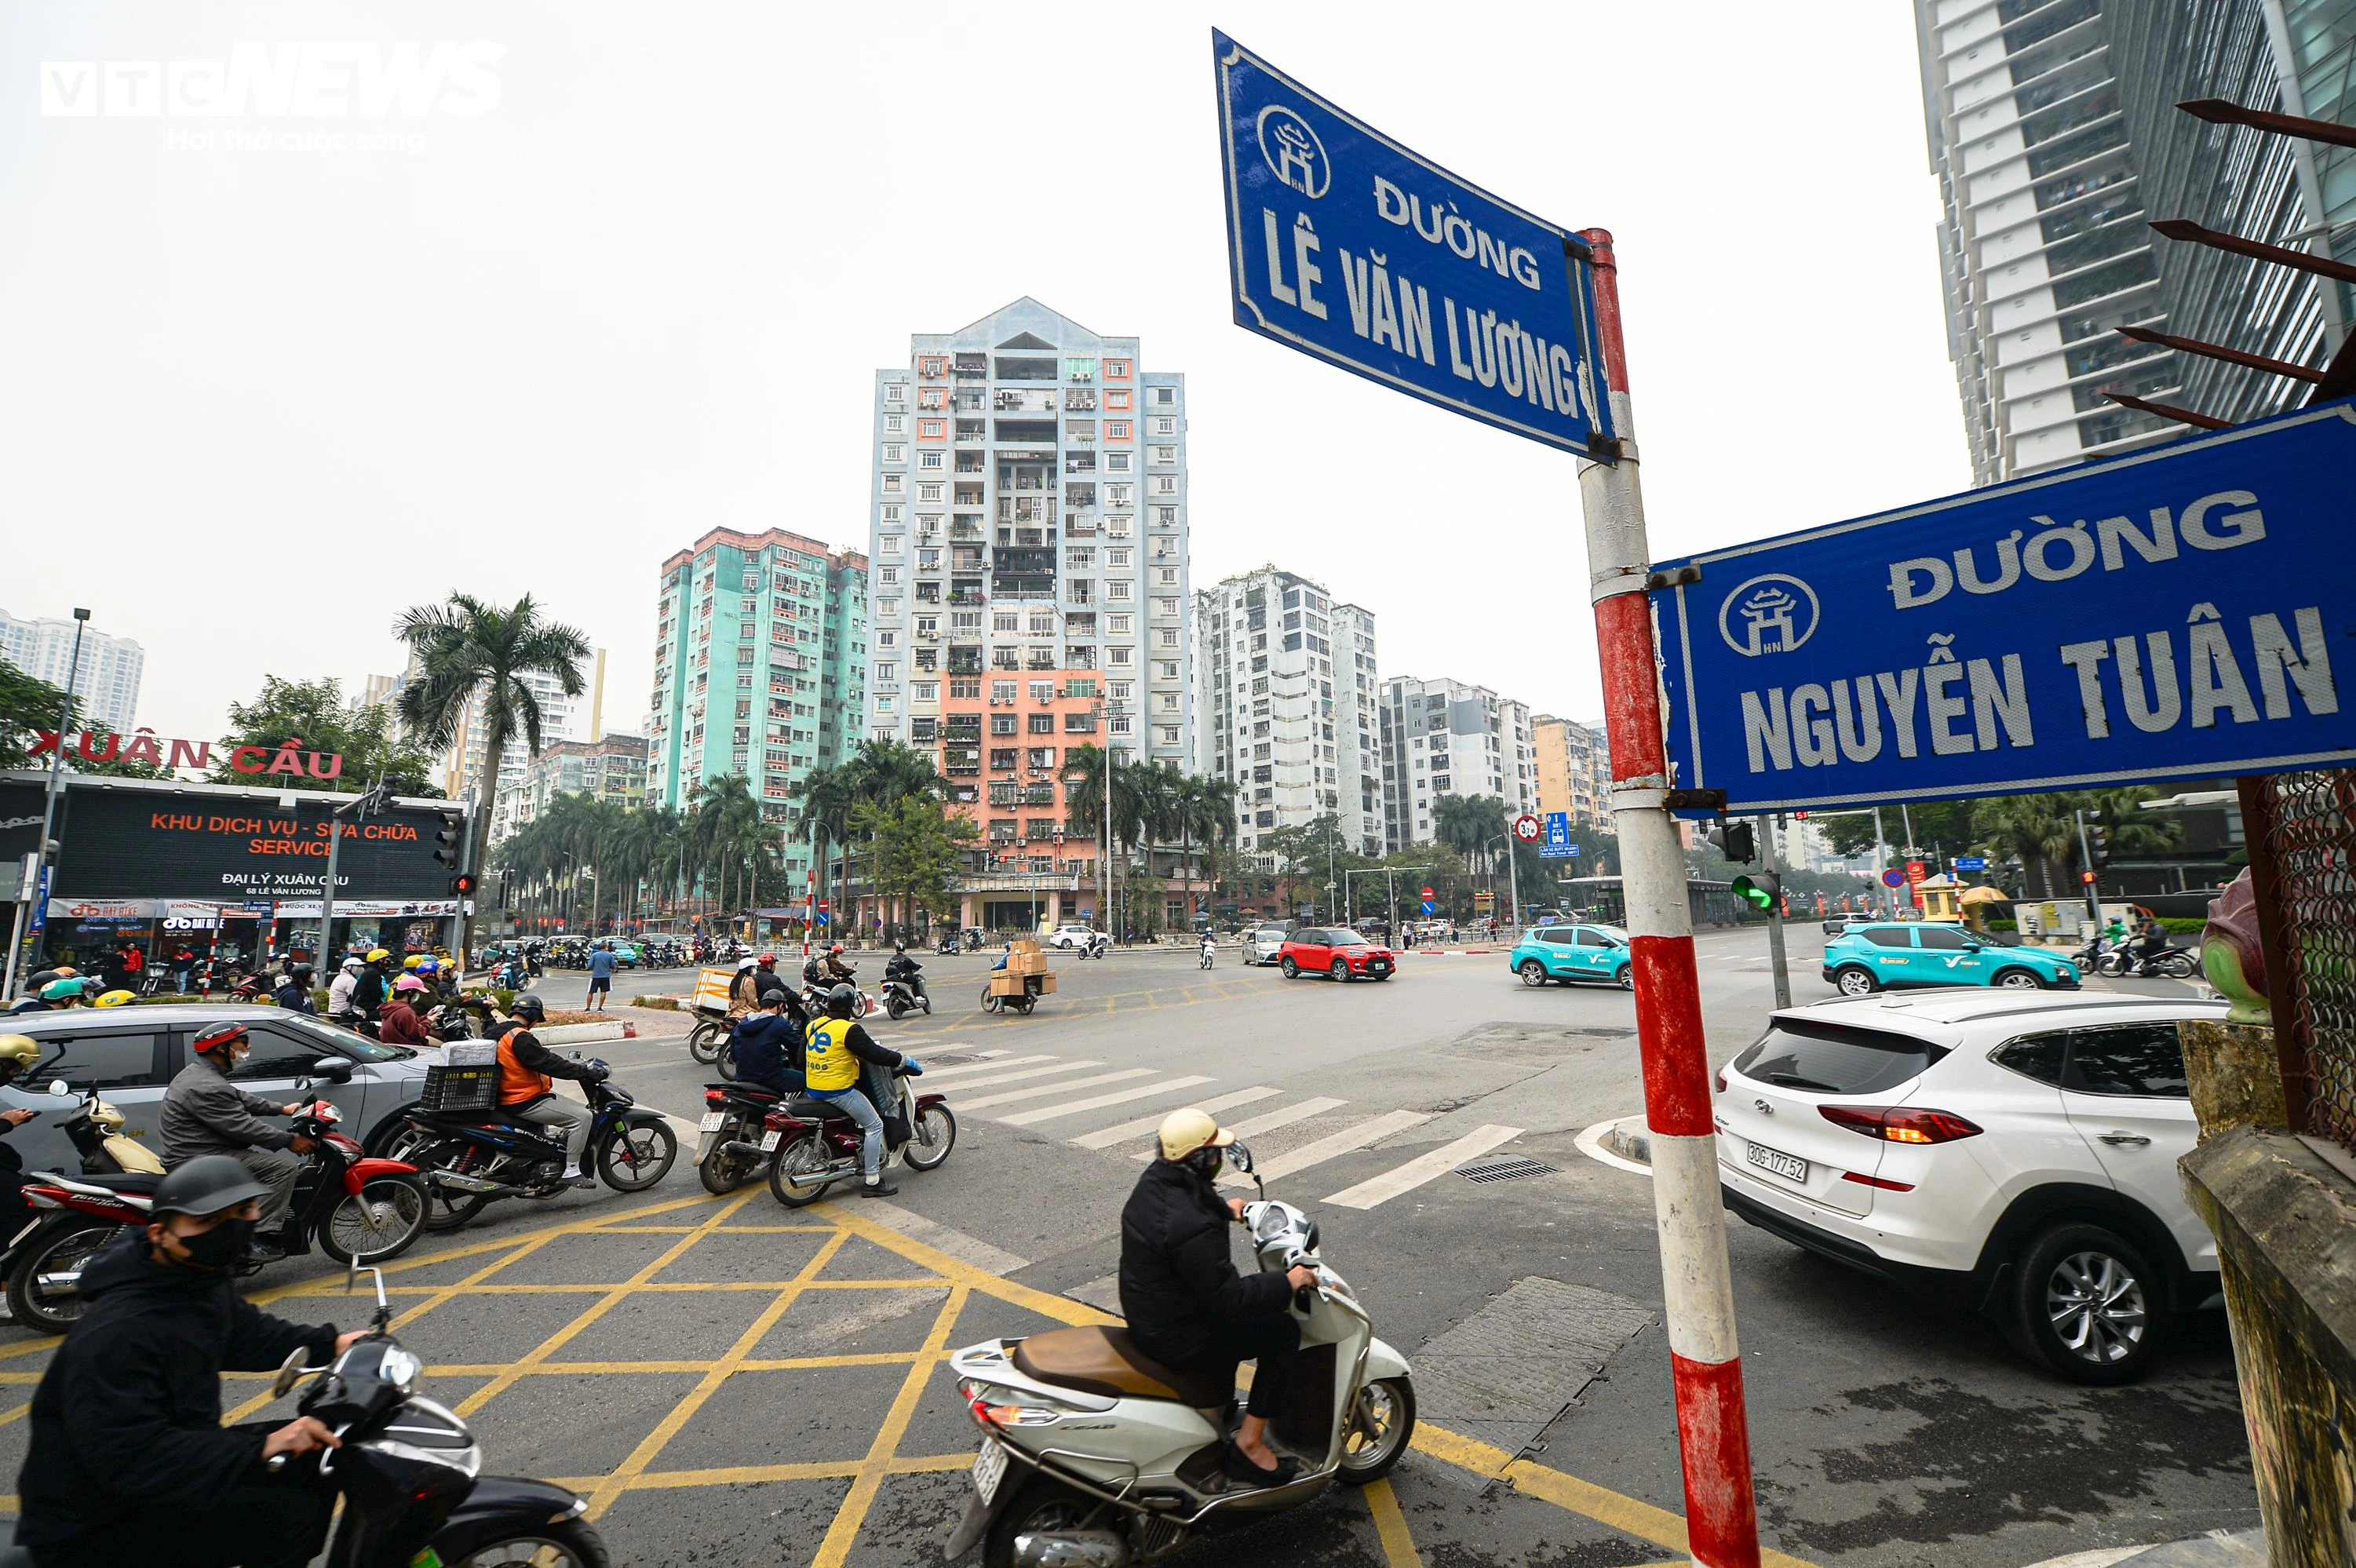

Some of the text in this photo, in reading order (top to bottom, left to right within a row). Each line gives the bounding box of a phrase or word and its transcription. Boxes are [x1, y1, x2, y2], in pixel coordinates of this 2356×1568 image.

[1374, 176, 1540, 290] ĐƯỜNG
[1264, 208, 1578, 419] LÊ VĂN LƯƠNG
[1887, 490, 2267, 611] ĐƯỜNG
[1763, 641, 1782, 654] HN
[1741, 602, 2339, 773] NGUYỄN TUÂN
[26, 727, 342, 779] XUÂN CẦU
[151, 813, 202, 831] KHU
[209, 817, 261, 836] DỊCH
[268, 820, 297, 837] VỤ
[364, 823, 418, 841] CHỮA
[248, 839, 332, 856] SERVICE
[222, 872, 349, 886] ĐẠI LÝ XUÂN CU
[206, 918, 225, 928] BIE
[808, 1023, 831, 1053] be
[1749, 1143, 1804, 1180] 30G-177.52
